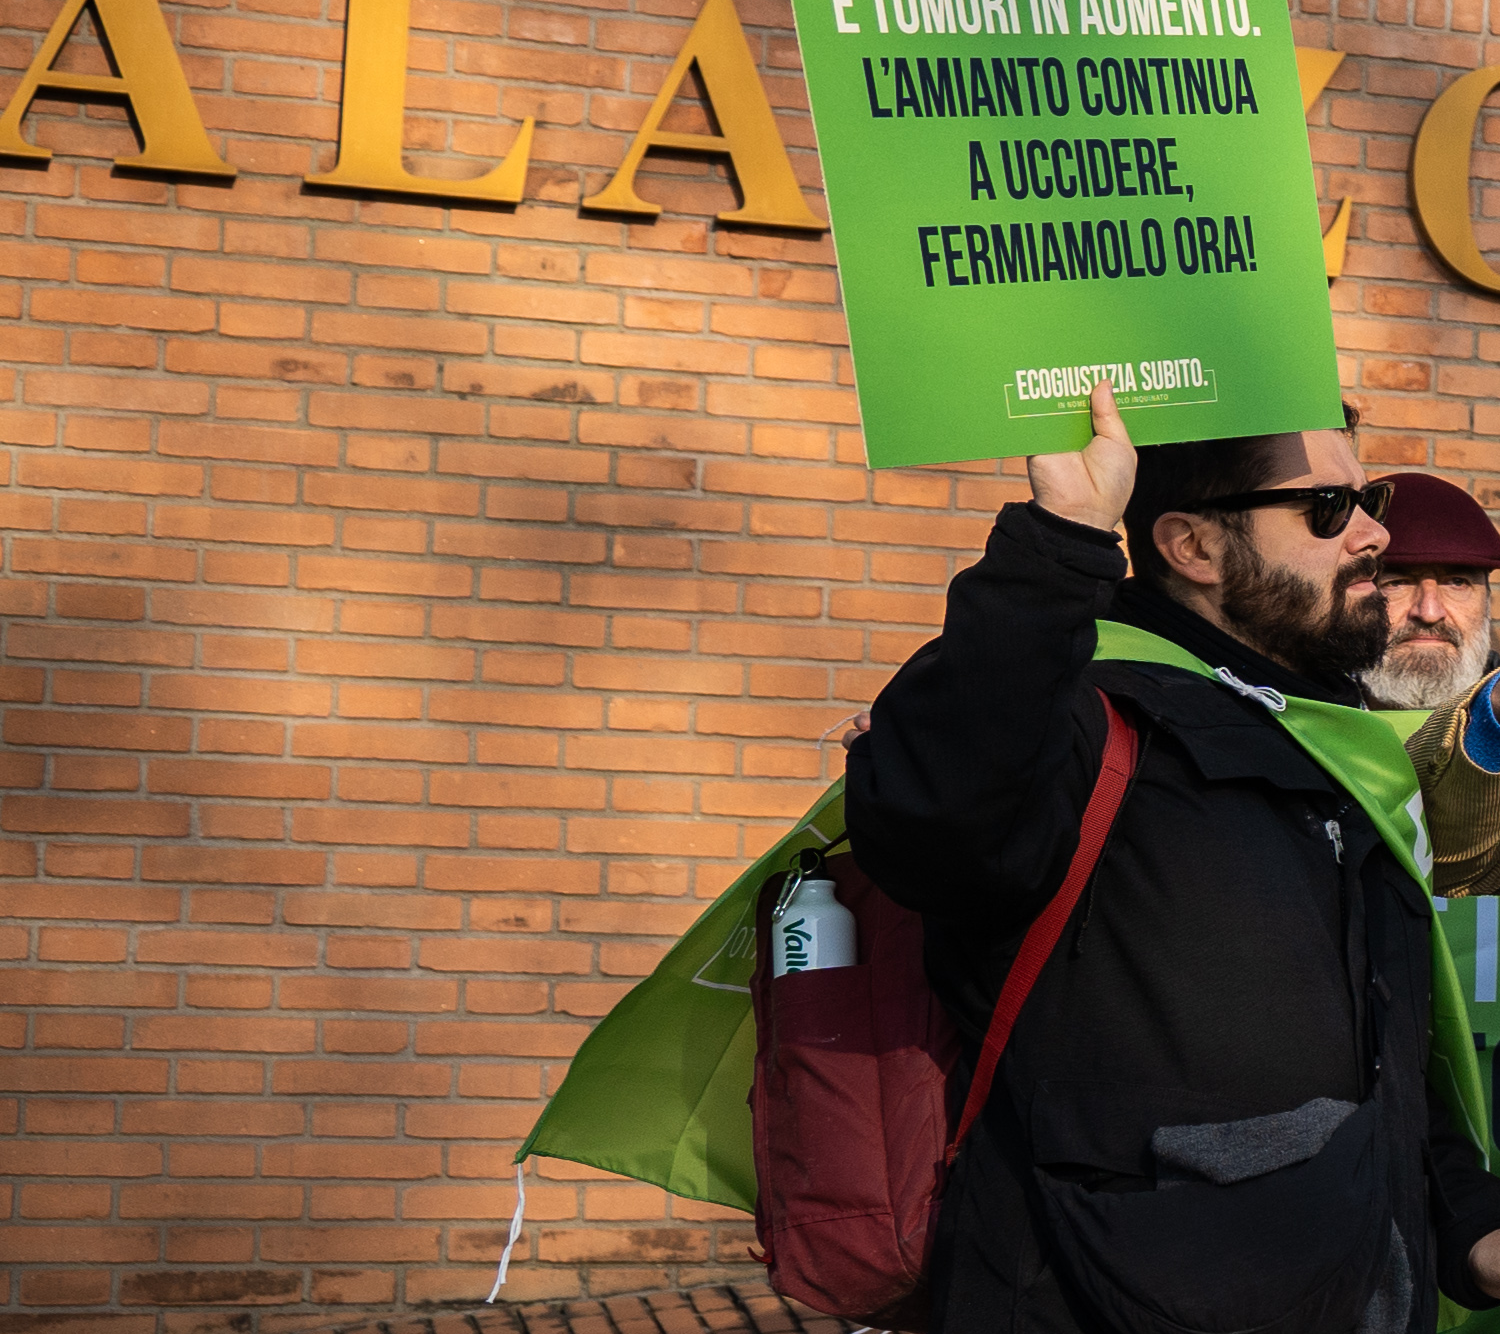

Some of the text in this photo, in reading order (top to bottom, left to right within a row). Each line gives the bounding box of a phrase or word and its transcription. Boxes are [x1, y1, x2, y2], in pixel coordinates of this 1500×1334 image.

[1079, 58, 1259, 117] CONTINUA
[969, 137, 1195, 203] A UCCIDERE,
[917, 215, 1259, 288] FERMIAMOLO ORA!
[1139, 358, 1208, 391] SUBITO.
